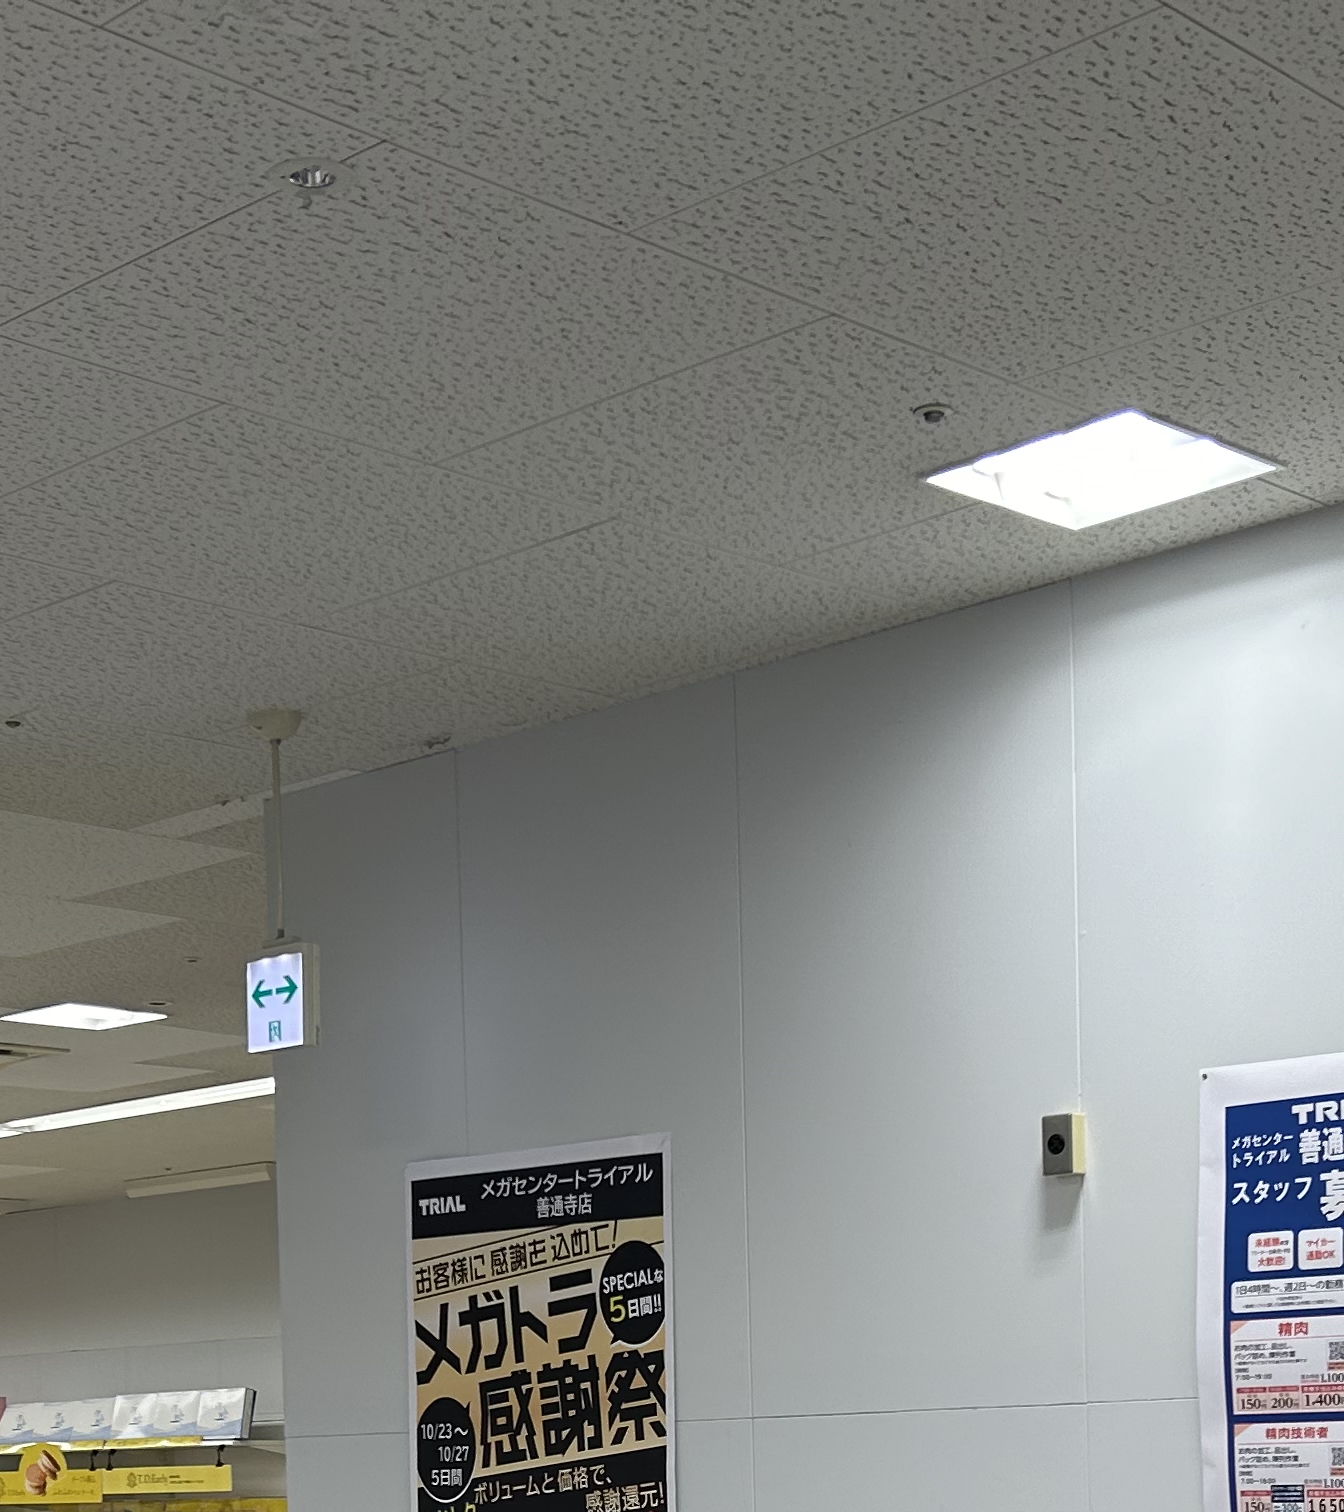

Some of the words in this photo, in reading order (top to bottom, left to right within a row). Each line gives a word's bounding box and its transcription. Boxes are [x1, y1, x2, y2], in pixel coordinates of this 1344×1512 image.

[1231, 1133, 1294, 1149] メガセンター
[1232, 1148, 1291, 1169] トライアル
[481, 1163, 653, 1199] メガセンタートライアル
[419, 1196, 466, 1215] TRIAL
[536, 1193, 592, 1218] 善通寺店
[416, 1270, 598, 1385] メガトラ
[1278, 1322, 1308, 1336] 精肉
[478, 1350, 666, 1469] 感謝祭
[1265, 1427, 1328, 1439] 精肉技術者
[438, 1446, 469, 1462] 10/27
[431, 1469, 462, 1486] 5日間
